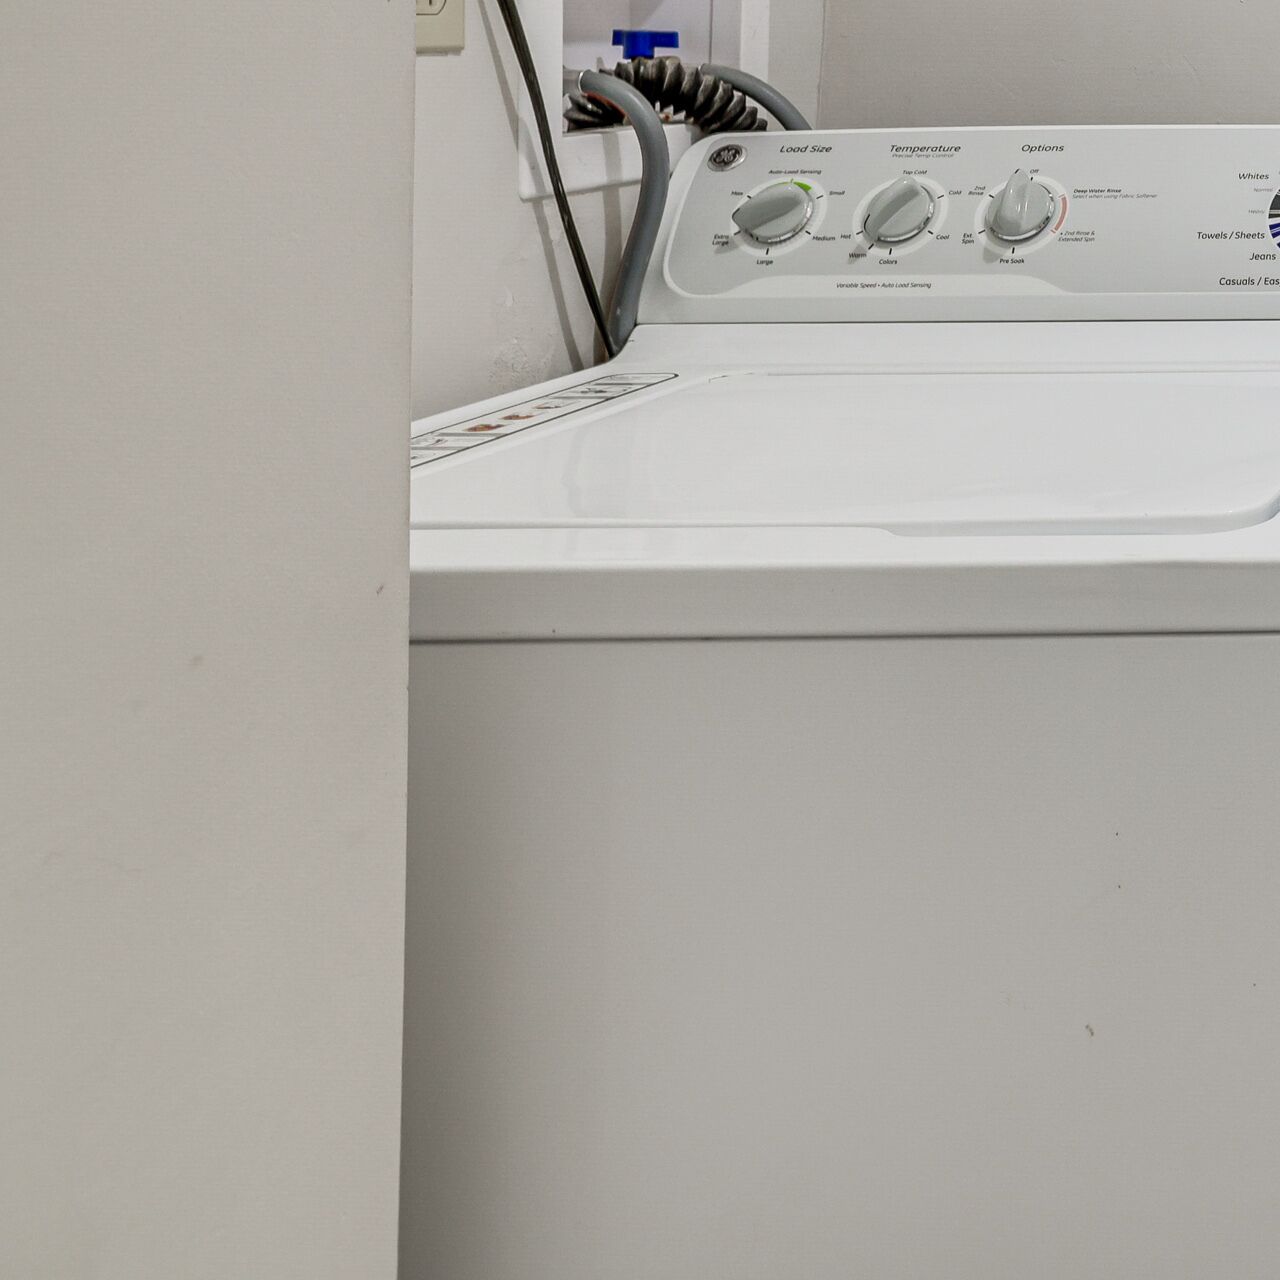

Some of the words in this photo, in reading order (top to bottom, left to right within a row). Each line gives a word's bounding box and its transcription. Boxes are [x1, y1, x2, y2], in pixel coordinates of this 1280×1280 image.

[780, 145, 809, 153] Load
[810, 145, 832, 153] Size
[890, 145, 962, 154] Temperature
[1022, 144, 1064, 154] Options
[1250, 253, 1277, 261] Jeans
[1220, 277, 1255, 286] Casuals
